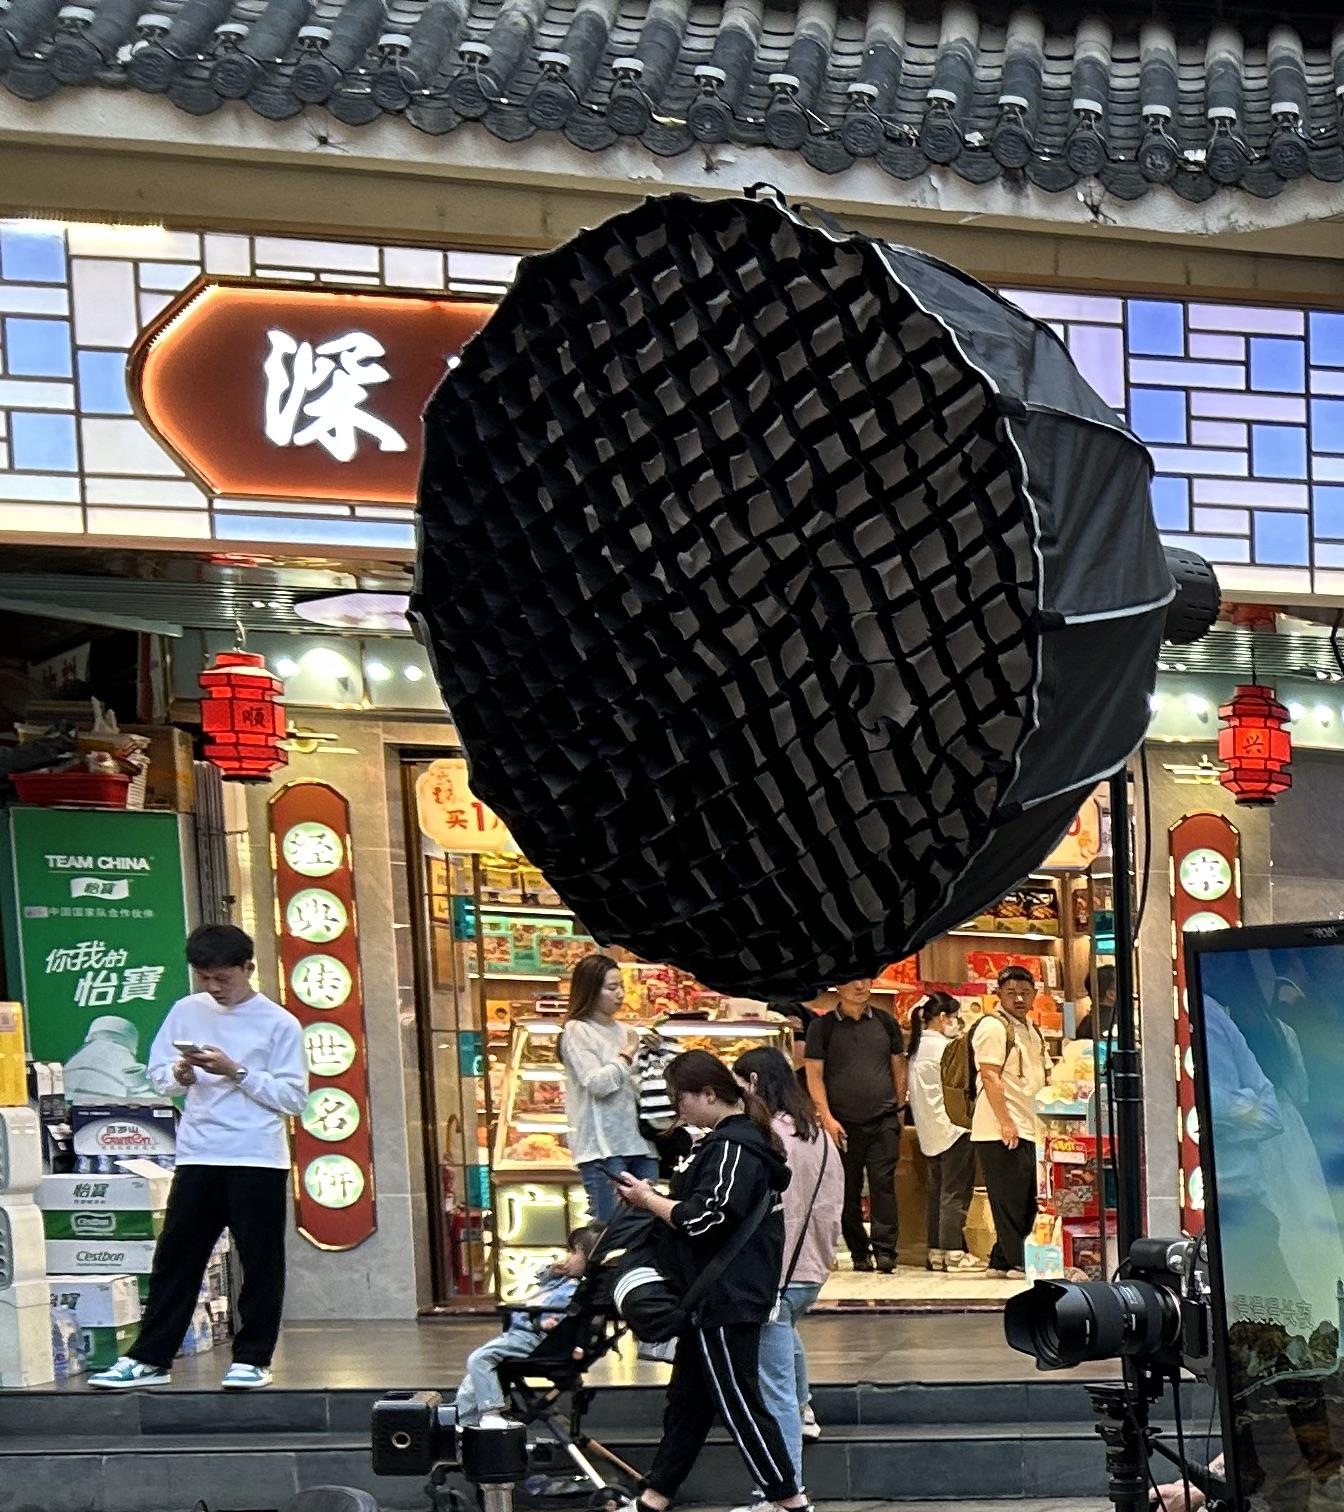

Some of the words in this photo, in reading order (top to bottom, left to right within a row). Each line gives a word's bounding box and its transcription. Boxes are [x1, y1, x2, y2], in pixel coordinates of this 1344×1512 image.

[265, 328, 412, 461] 深
[44, 855, 93, 869] TEAM
[97, 856, 151, 871] CHINA
[45, 940, 128, 973] 你我的
[73, 965, 165, 1007] 怡寶
